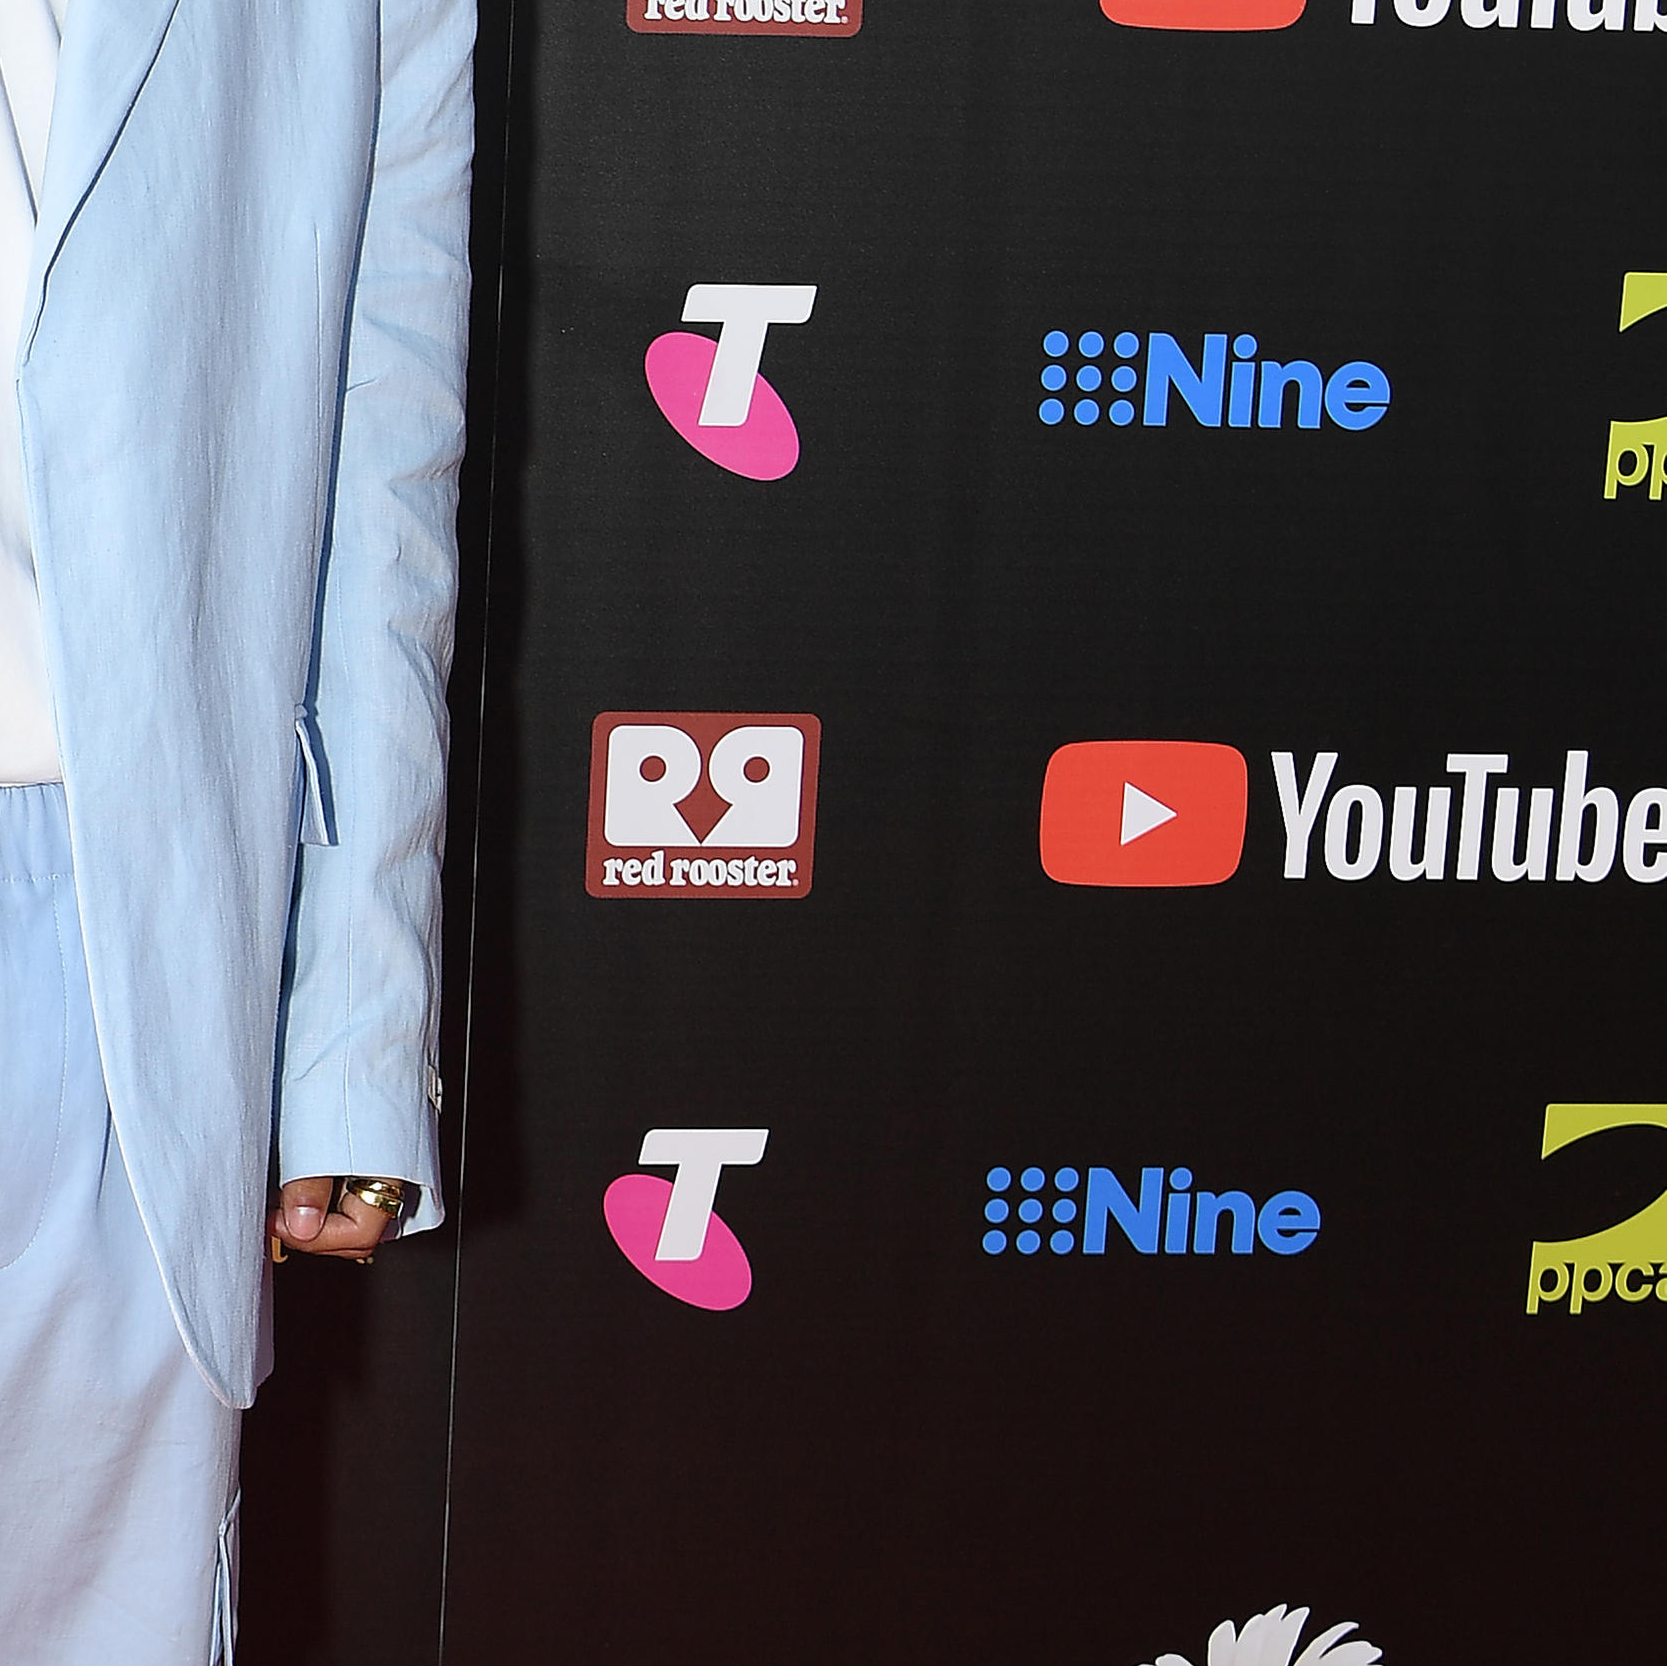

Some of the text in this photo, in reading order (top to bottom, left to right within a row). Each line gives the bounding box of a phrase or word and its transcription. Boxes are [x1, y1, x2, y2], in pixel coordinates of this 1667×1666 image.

[1142, 332, 1391, 431] Nine
[1270, 750, 1667, 883] YouTube
[602, 849, 665, 886] red
[1082, 1167, 1321, 1255] Nine
[1525, 1259, 1667, 1308] ppc
